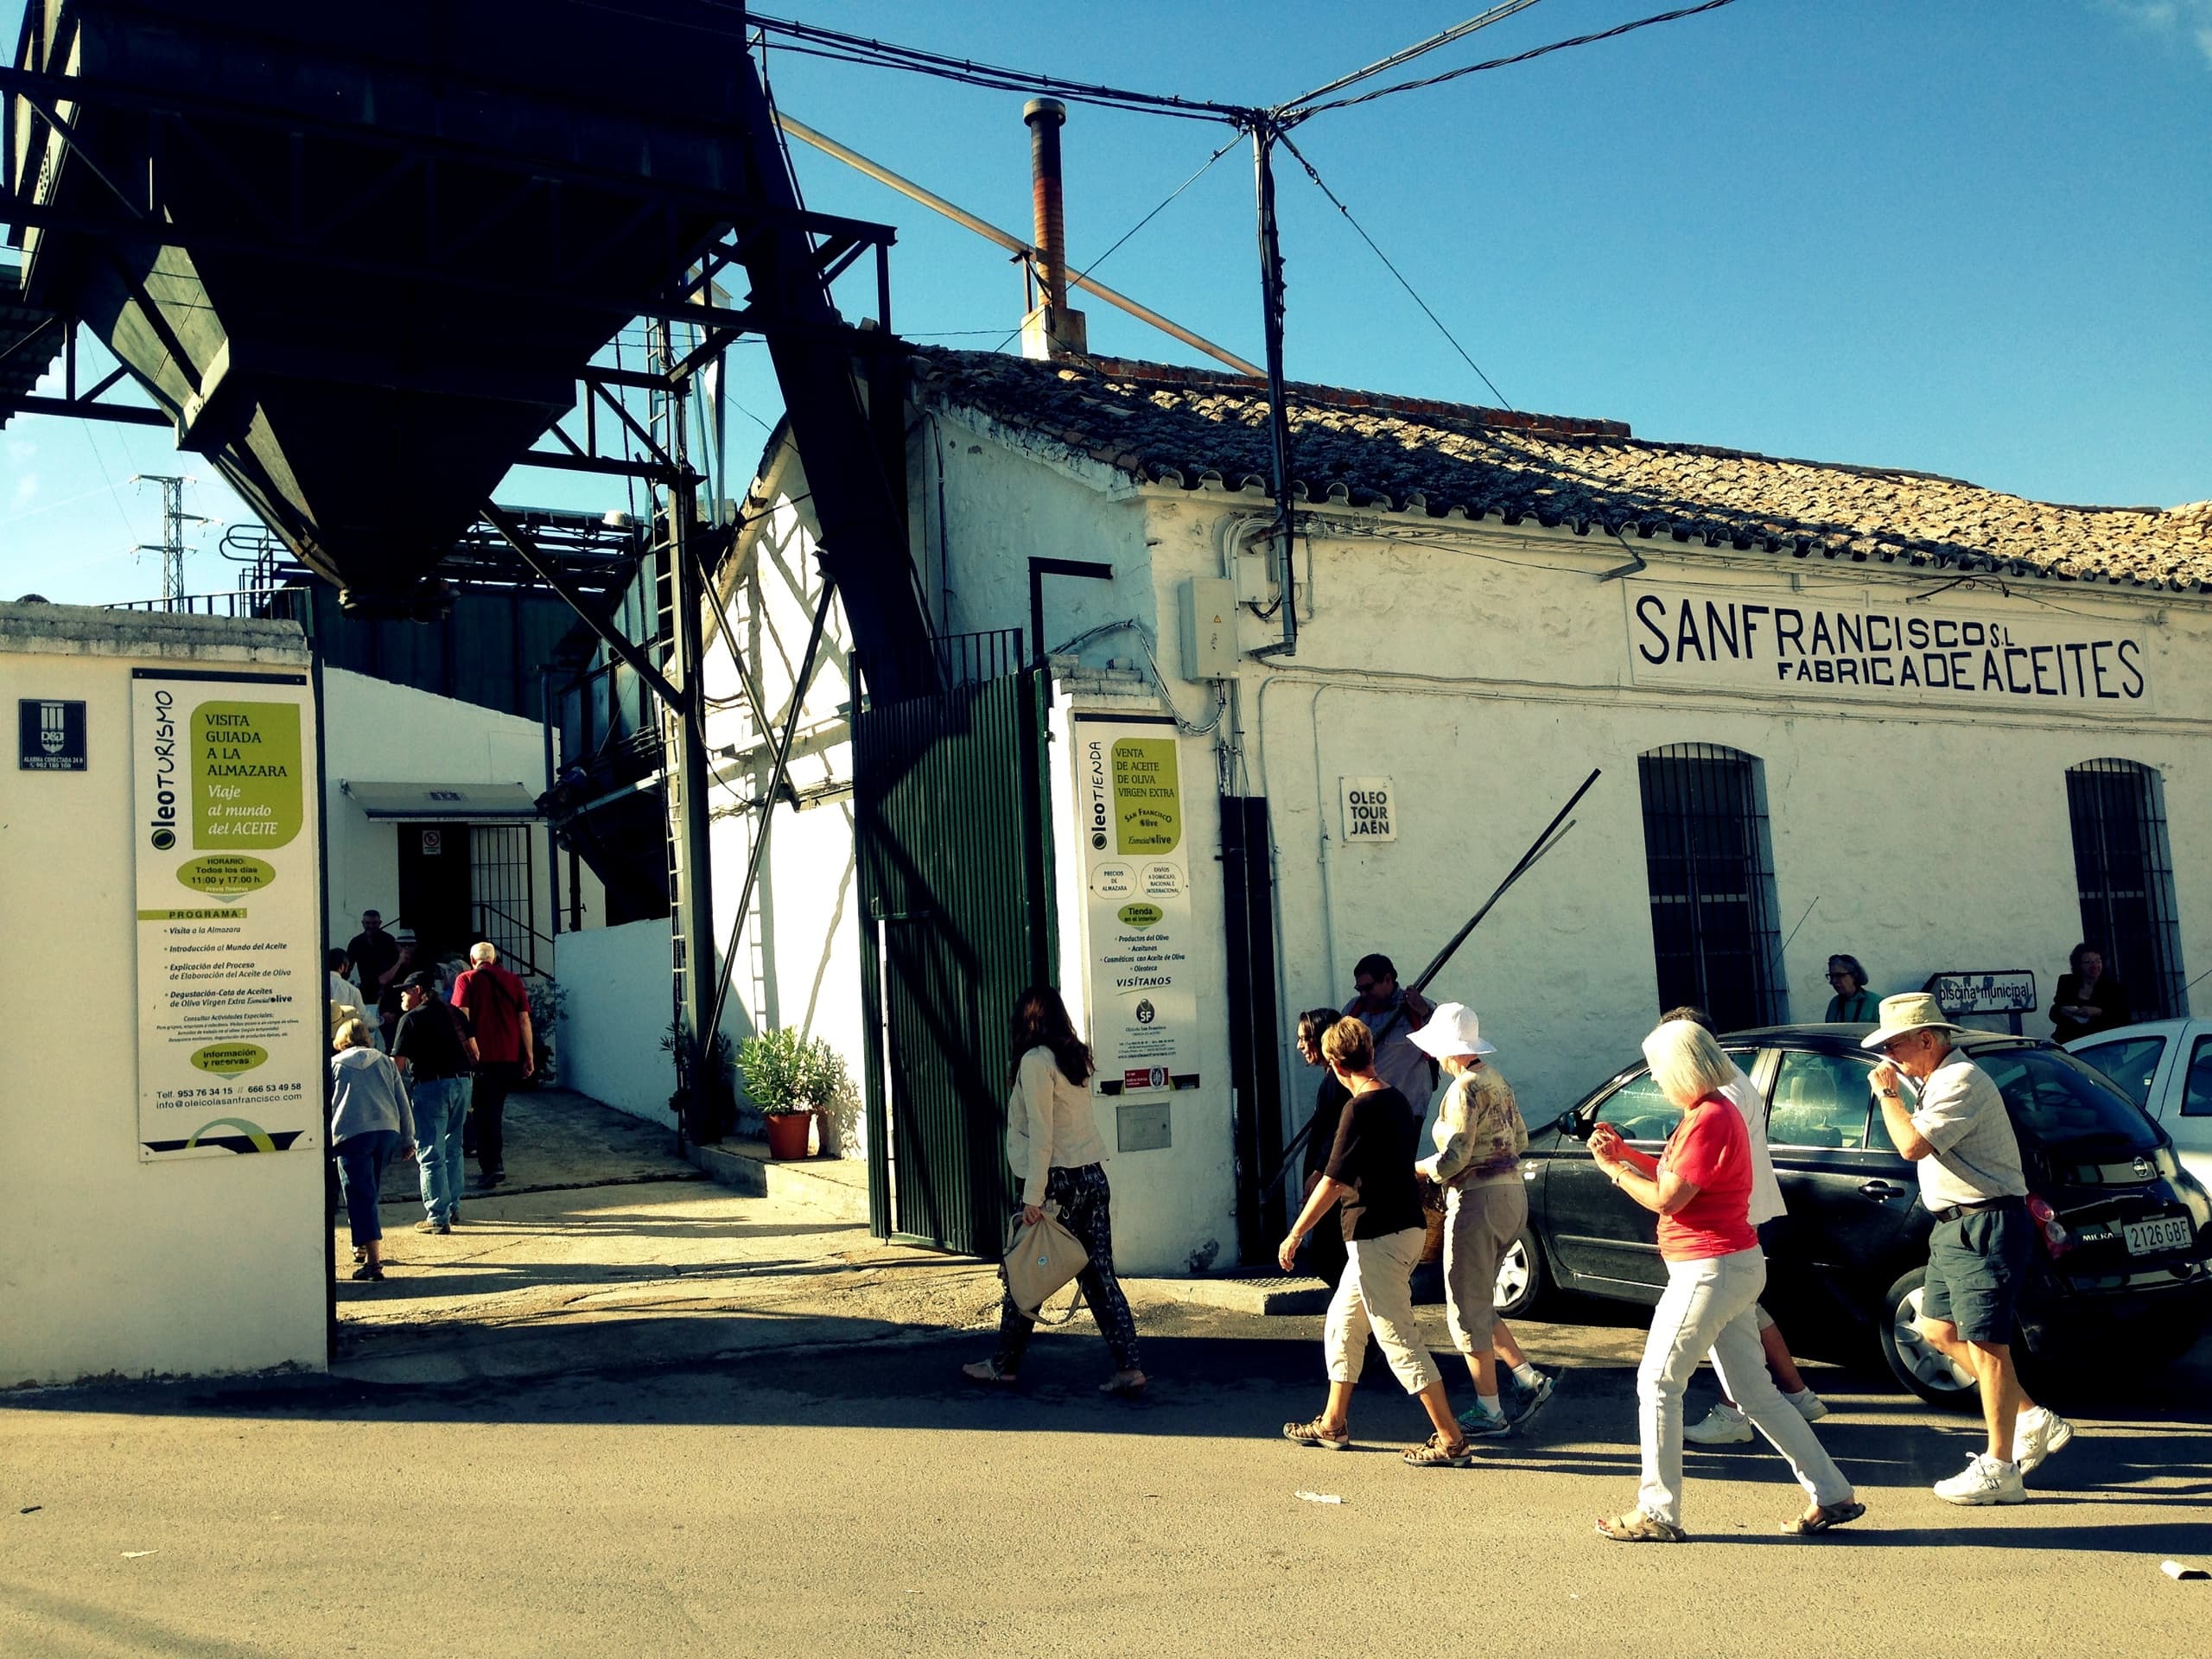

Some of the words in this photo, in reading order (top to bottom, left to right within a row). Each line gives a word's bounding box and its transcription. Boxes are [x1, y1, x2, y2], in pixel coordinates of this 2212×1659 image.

[206, 714, 250, 727] VISITA
[206, 731, 262, 743] GUIADA
[207, 748, 217, 759] A
[223, 748, 241, 760] LA
[1116, 748, 1144, 758] VENTA
[207, 764, 288, 777] ALMAZARA
[1116, 761, 1128, 771] DE
[1131, 761, 1160, 772] ACEITE
[1117, 774, 1129, 784] DE
[1131, 774, 1156, 785] OLIVA
[208, 785, 241, 800] Viaje
[1118, 787, 1147, 798] VIRGEN
[1149, 788, 1175, 798] EXTRA
[1349, 791, 1388, 804] OLEO
[208, 804, 221, 817] al
[226, 804, 271, 817] mundo
[1351, 806, 1389, 819] TOUR
[208, 823, 228, 835] del
[232, 822, 278, 835] ACEITE
[228, 875, 251, 884] 17:00
[169, 944, 215, 953] Introducción
[169, 963, 211, 971] Explicación
[181, 971, 224, 980] Elaboración
[1116, 976, 1172, 987] VISÍTANOS
[1940, 985, 1976, 1003] piscina
[1981, 982, 2030, 999] municipal
[202, 998, 226, 1007] Virgen
[1140, 1010, 1152, 1021] SF
[203, 1048, 256, 1058] Información
[177, 1089, 194, 1097] 953
[156, 1093, 302, 1109] info@oleicolasanfrancisco.com
[2131, 1224, 2164, 1248] 2126
[2165, 1220, 2187, 1243] GBF
